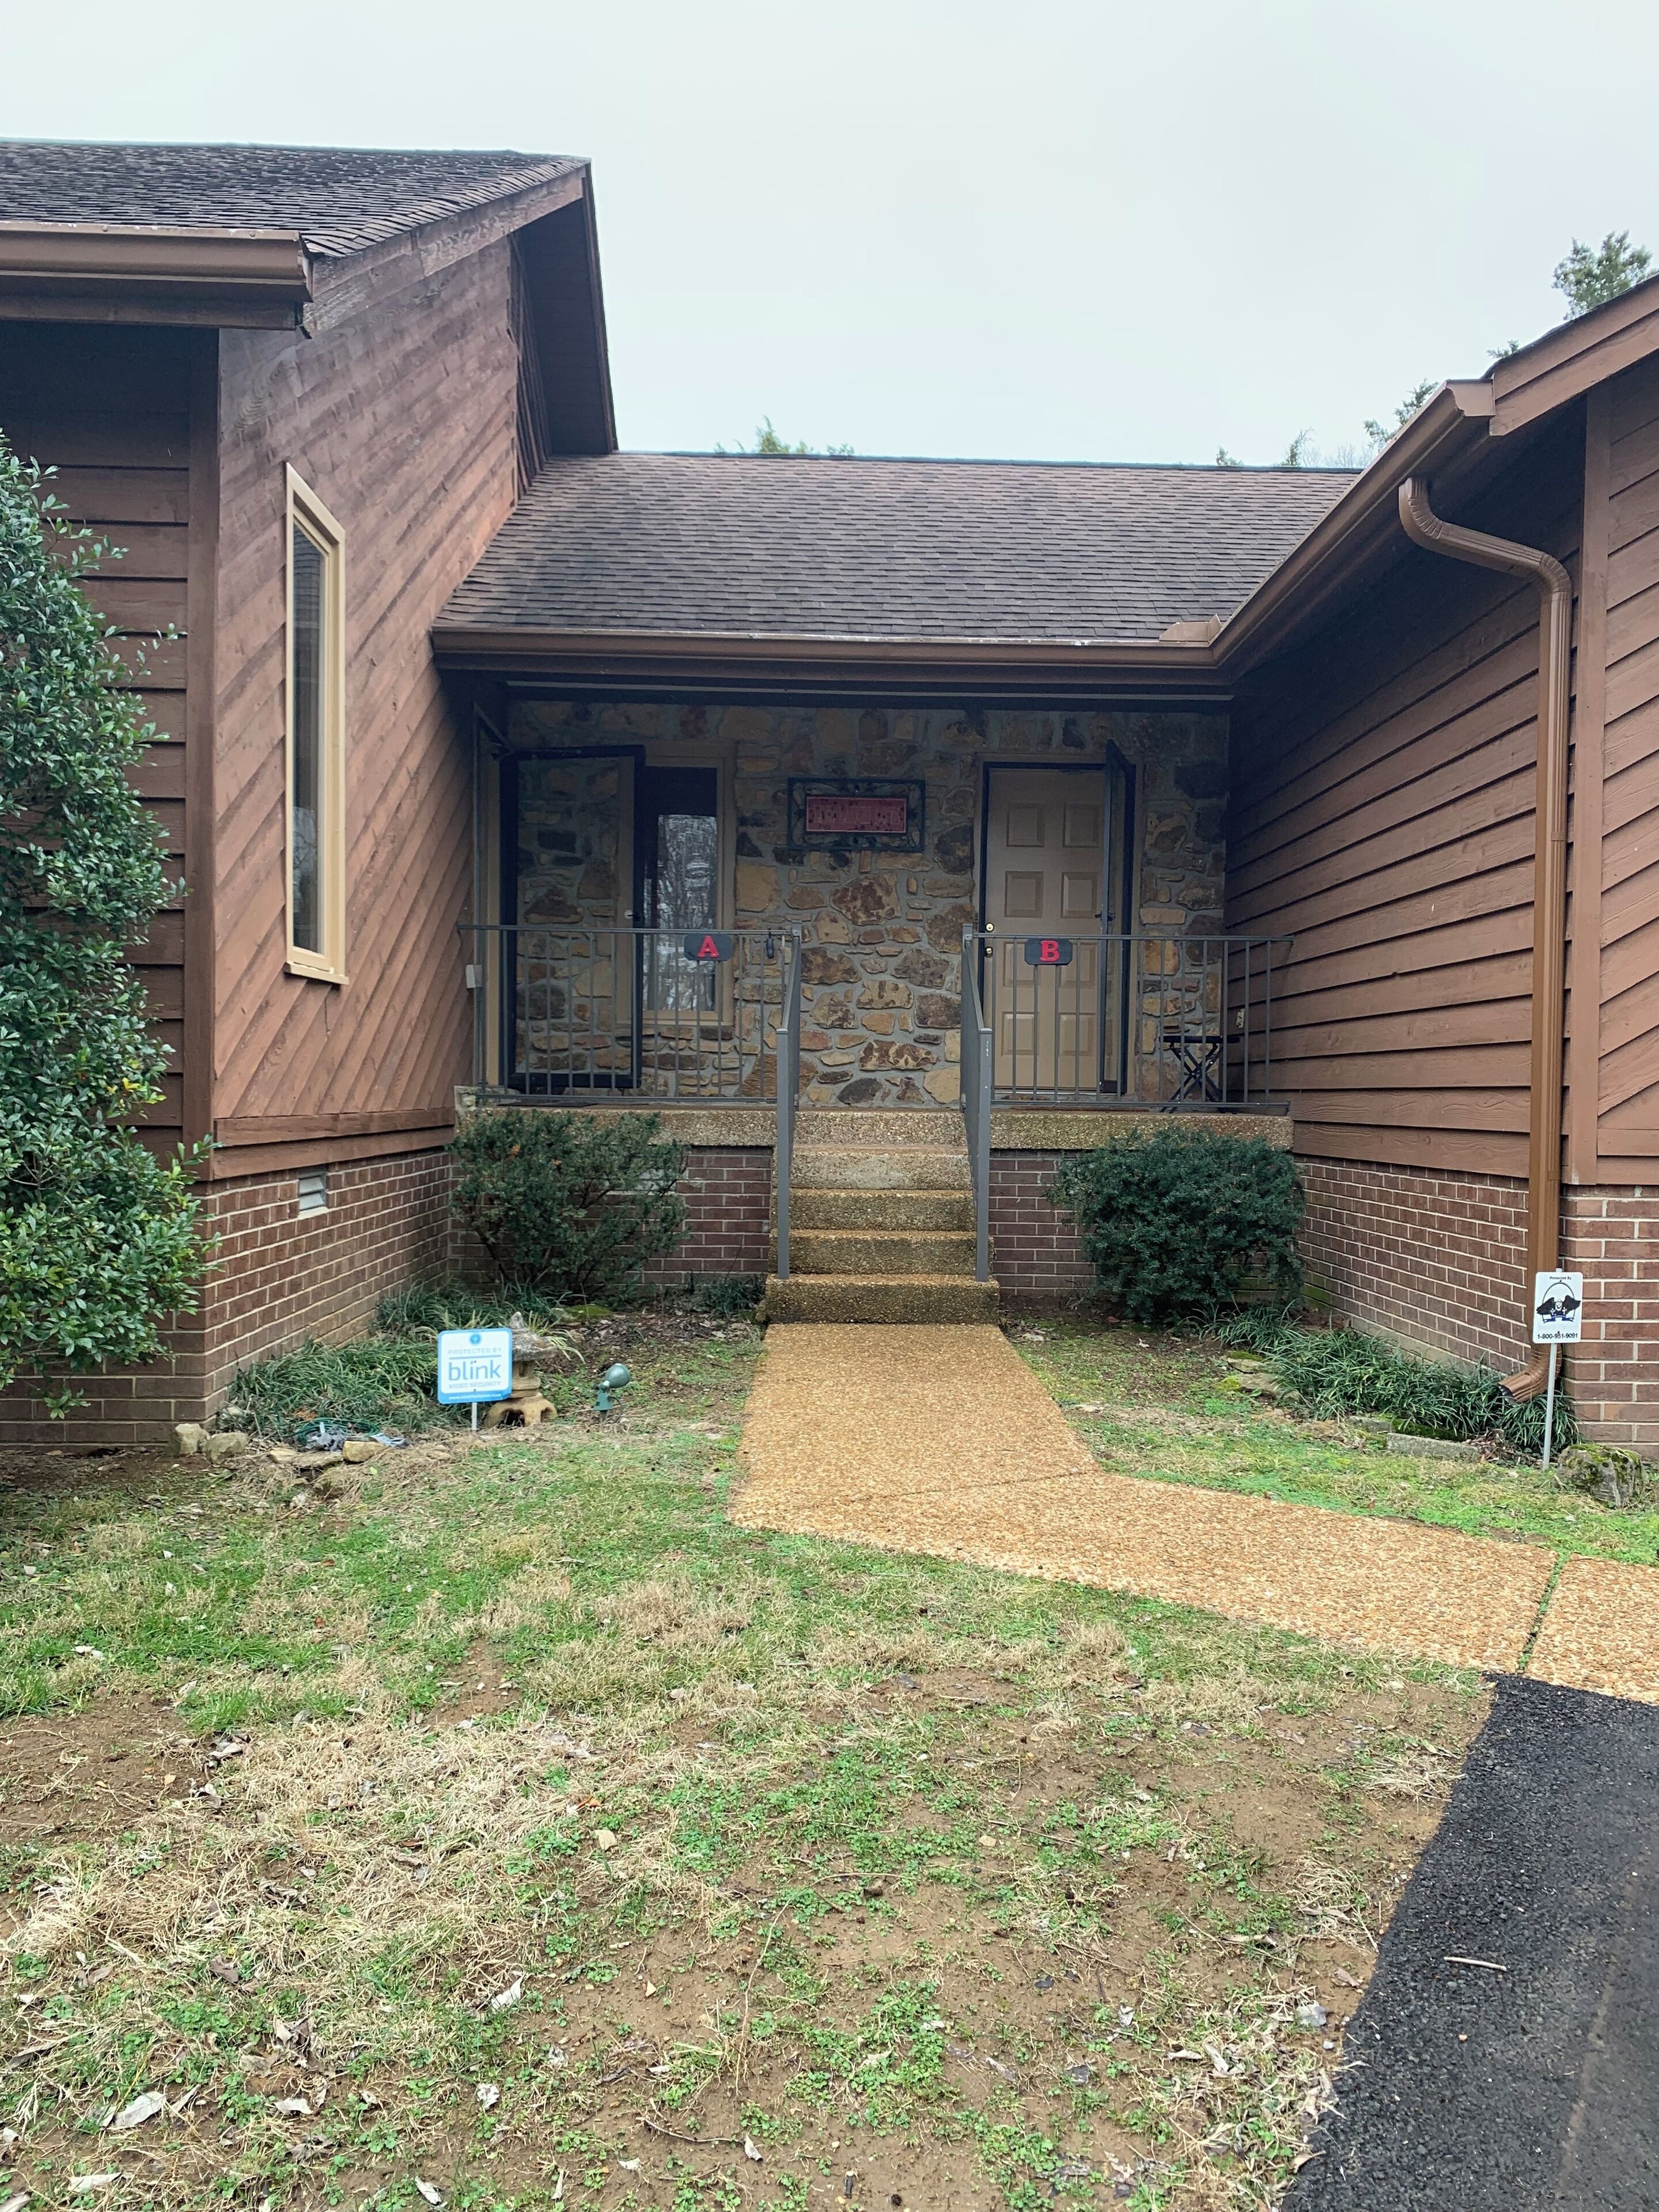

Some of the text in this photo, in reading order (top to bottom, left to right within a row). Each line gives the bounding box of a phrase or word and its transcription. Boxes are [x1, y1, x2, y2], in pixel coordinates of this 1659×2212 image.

[698, 935, 719, 958] A
[1040, 940, 1060, 961] B
[449, 1360, 501, 1381] blink
